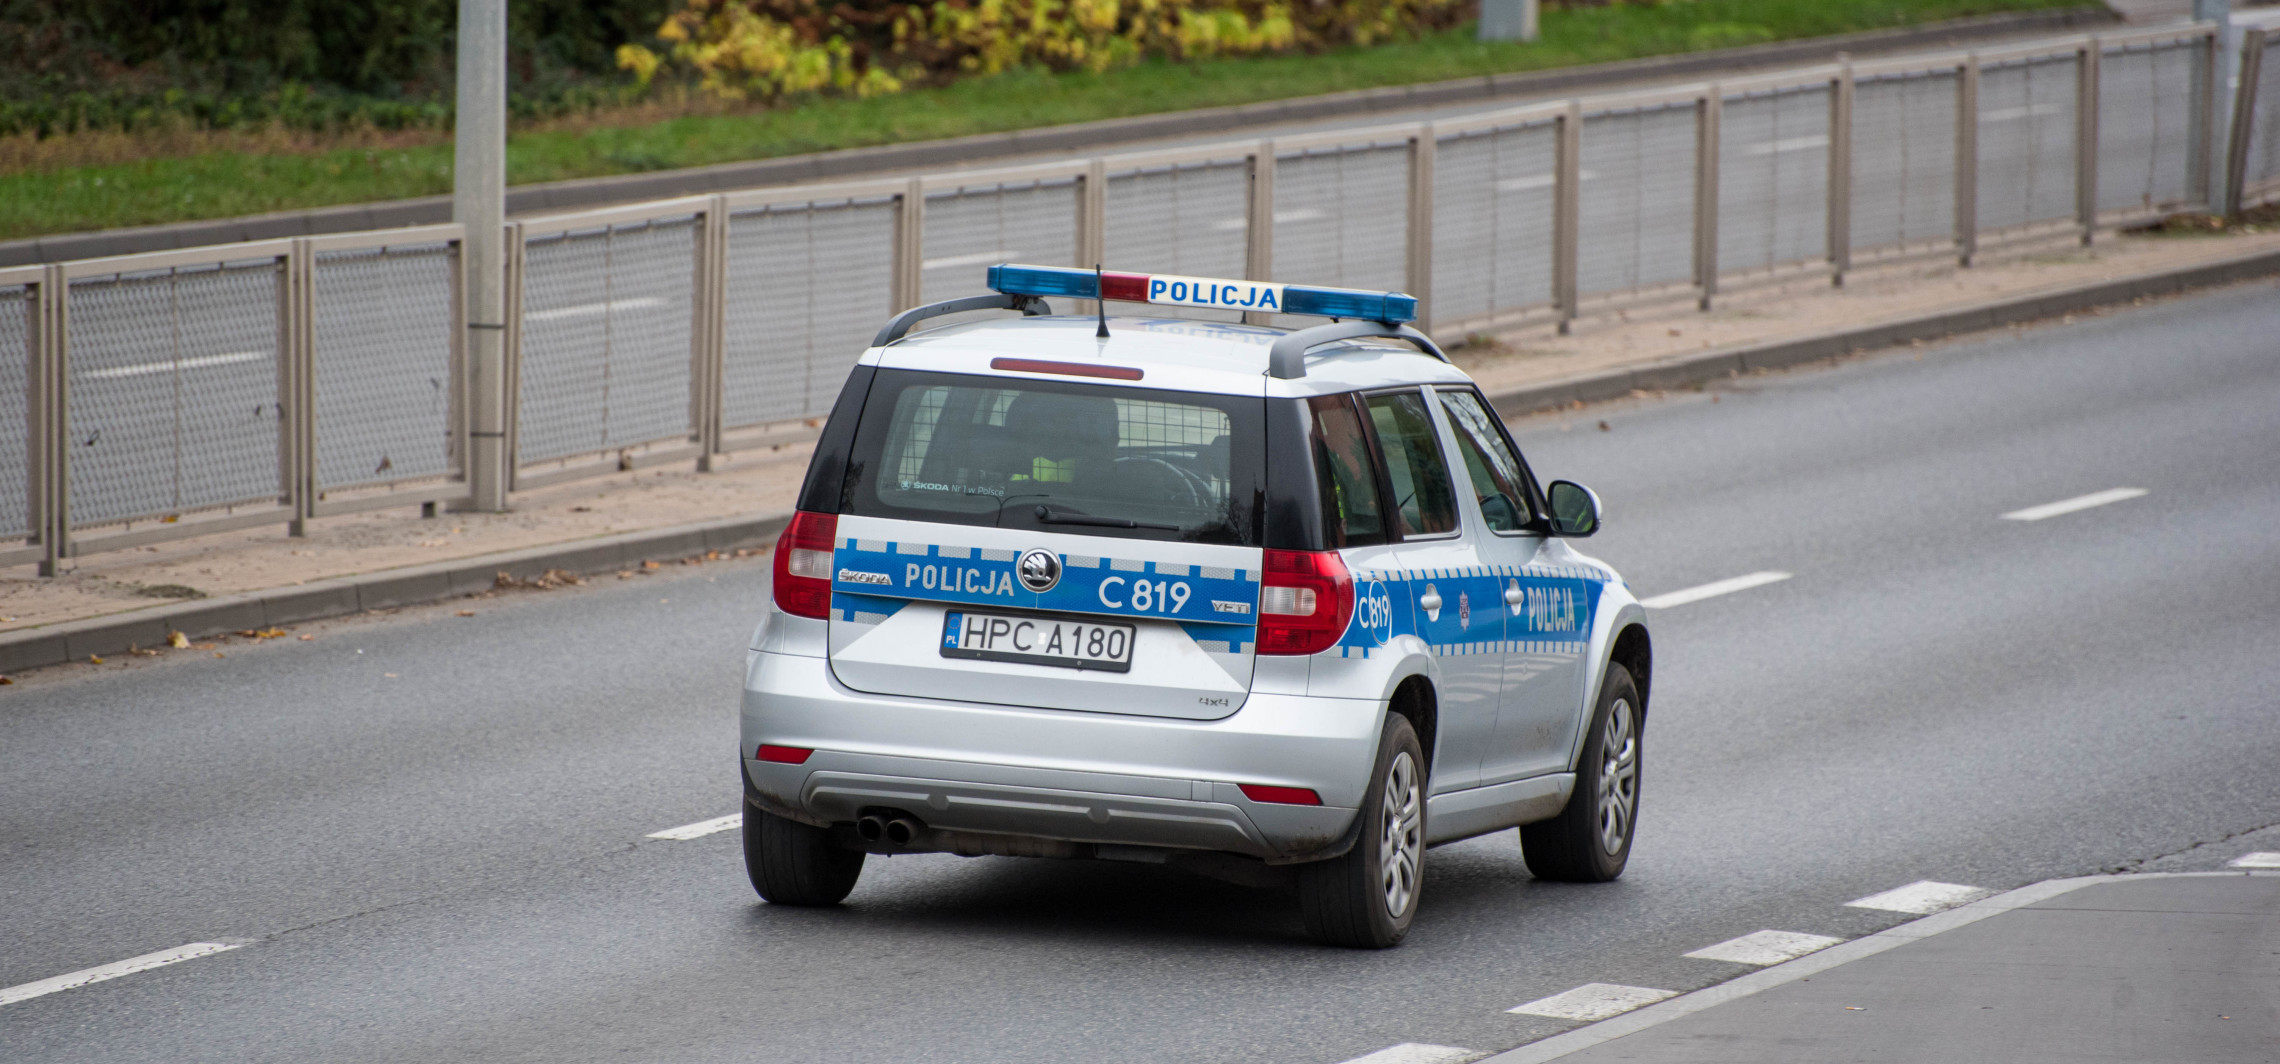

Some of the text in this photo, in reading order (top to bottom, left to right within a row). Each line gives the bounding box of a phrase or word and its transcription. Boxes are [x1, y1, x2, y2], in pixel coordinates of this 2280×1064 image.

[1150, 280, 1278, 309] POLICJA
[913, 481, 949, 491] ŠKODA
[951, 484, 961, 492] Nr
[978, 486, 1004, 497] Polsce
[838, 568, 893, 586] ŠKODA
[905, 563, 1014, 597] POLICJA
[1098, 576, 1191, 614] C 819
[1210, 600, 1251, 614] YETI
[1527, 587, 1576, 632] POLICJA
[1358, 595, 1389, 629] C 819
[945, 635, 957, 645] PL
[964, 616, 1126, 660] HPC A180
[1199, 697, 1229, 707] 4x4
